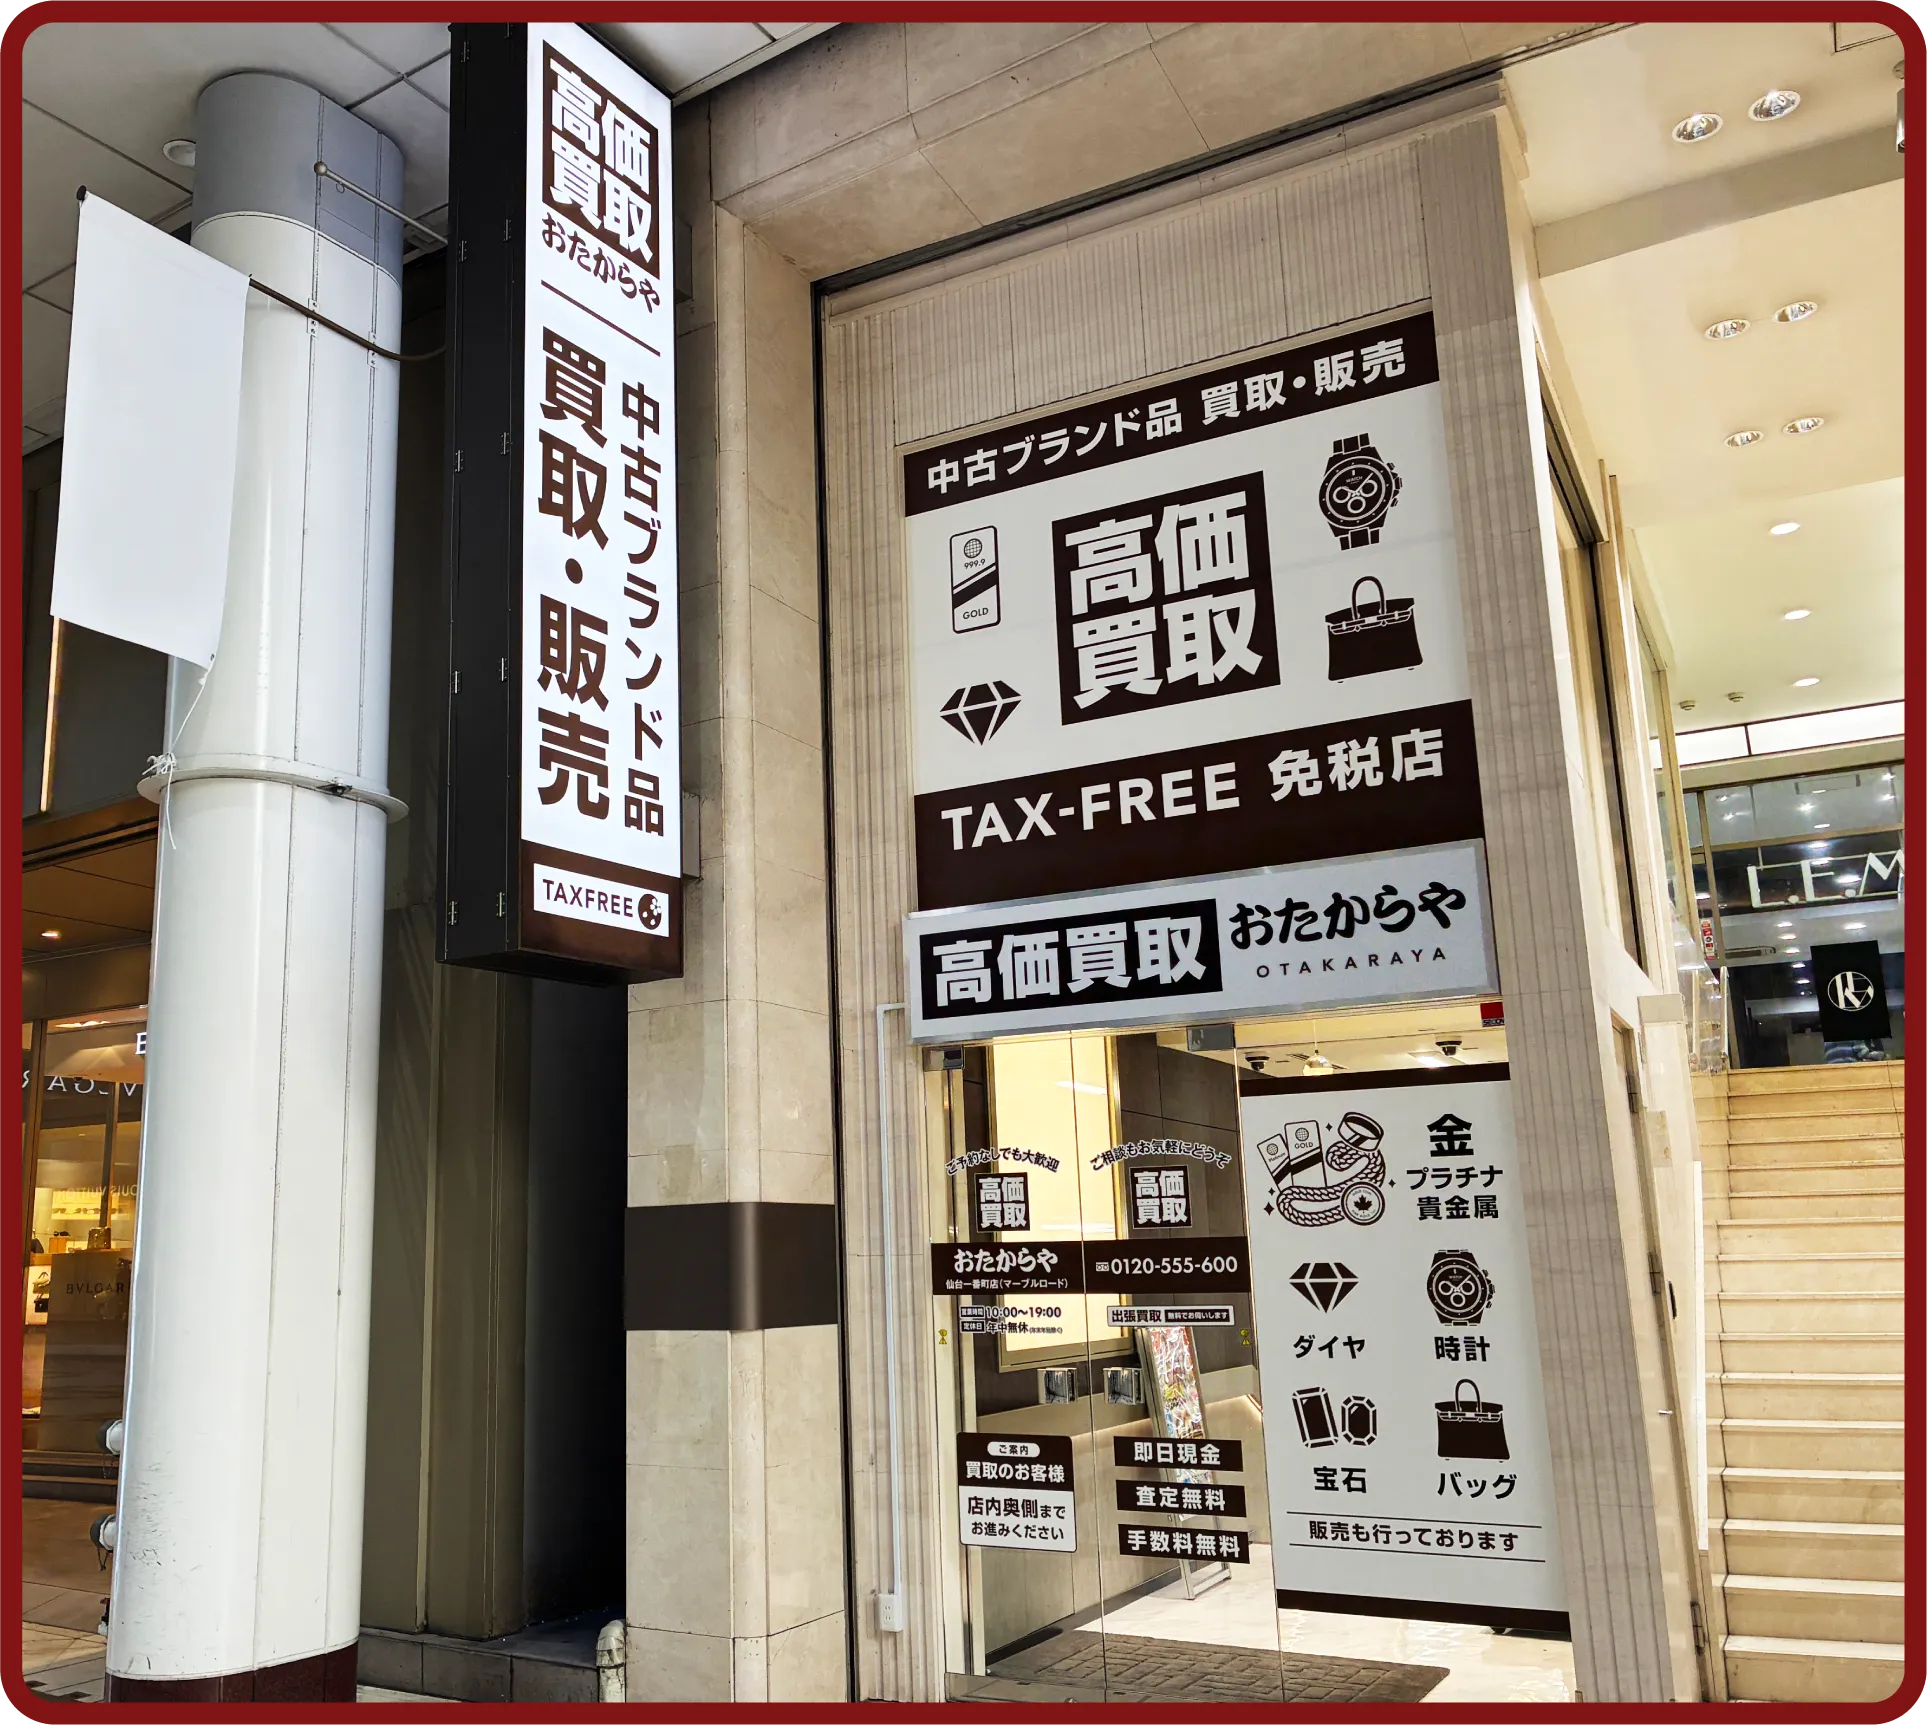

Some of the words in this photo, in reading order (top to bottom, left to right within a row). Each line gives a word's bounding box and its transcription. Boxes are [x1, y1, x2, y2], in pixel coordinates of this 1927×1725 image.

[549, 57, 652, 195] 高価
[549, 130, 654, 263] 買取
[541, 212, 660, 314] おたからや
[927, 397, 1183, 495] 中古ブランド品
[1201, 337, 1406, 425] 買取・販売
[963, 558, 986, 570] 999.9
[1065, 490, 1250, 615] 高価
[537, 326, 609, 820] 買取・販売
[620, 381, 664, 837] 中古ブランド品
[962, 607, 989, 620] GOLD
[1072, 588, 1263, 710] 買取
[941, 761, 1240, 851] TAX-FREE
[1268, 727, 1444, 803] 免税店
[542, 878, 633, 918] TAXFREE
[1229, 881, 1466, 950] おたからや
[932, 916, 1206, 1008] 高価買取
[1256, 947, 1446, 979] OTAKARAYA
[1294, 1142, 1313, 1150] GOLD
[1426, 1113, 1474, 1157] 金
[946, 1147, 1060, 1175] ご予約なしでも大歓迎
[1090, 1139, 1232, 1170] ご相談もお気軽にどうぞ
[979, 1176, 1025, 1203] 高価
[1133, 1170, 1185, 1198] 高価
[1406, 1165, 1503, 1190] プラチナ
[980, 1202, 1028, 1228] 買取
[1136, 1197, 1188, 1225] 買取
[1416, 1195, 1499, 1221] 貴金属
[953, 1247, 1058, 1273] おたからや
[1110, 1256, 1238, 1275] 0120-555-600
[963, 1322, 983, 1331] 定休日
[987, 1322, 1028, 1334] 年中無休
[1112, 1309, 1161, 1322] 出張買取
[1167, 1311, 1228, 1320] 無料でお伺いします
[1293, 1335, 1365, 1360] ダイヤ
[1434, 1336, 1490, 1362] 時計
[998, 1445, 1029, 1456] ご案内
[1134, 1441, 1220, 1466] 即日現金
[966, 1461, 1065, 1483] 買取のお客様
[1313, 1466, 1367, 1494] 宝石
[1438, 1472, 1517, 1500] バッグ
[967, 1496, 1066, 1519] 店内奥側まで
[1136, 1485, 1225, 1511] 査定無料
[971, 1521, 1064, 1540] お進みください
[1127, 1529, 1240, 1558] 手数料無料
[1309, 1520, 1518, 1552] 販売も行っております
